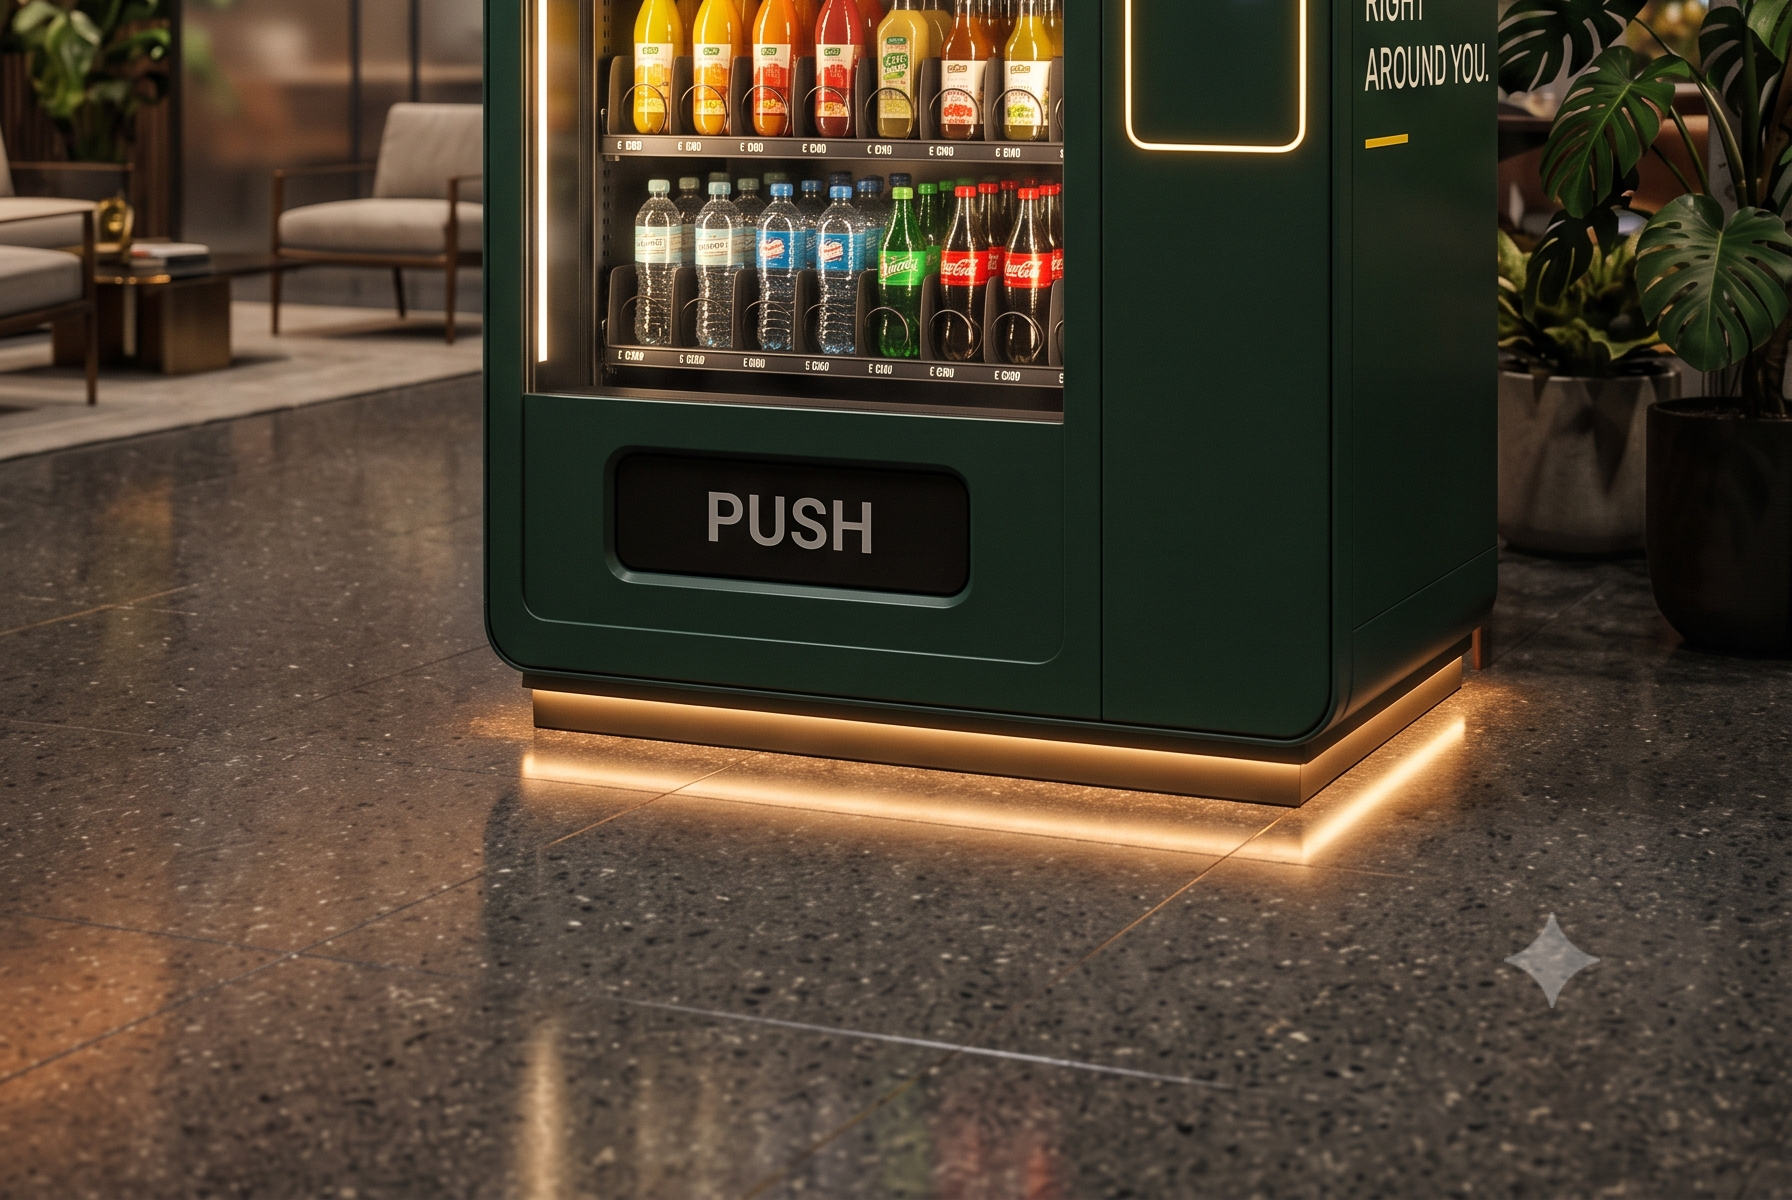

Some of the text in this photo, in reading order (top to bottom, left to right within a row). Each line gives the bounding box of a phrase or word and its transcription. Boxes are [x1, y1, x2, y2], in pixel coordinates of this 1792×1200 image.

[1364, 42, 1489, 92] AROUND YOU.
[708, 491, 872, 554] PUSH
